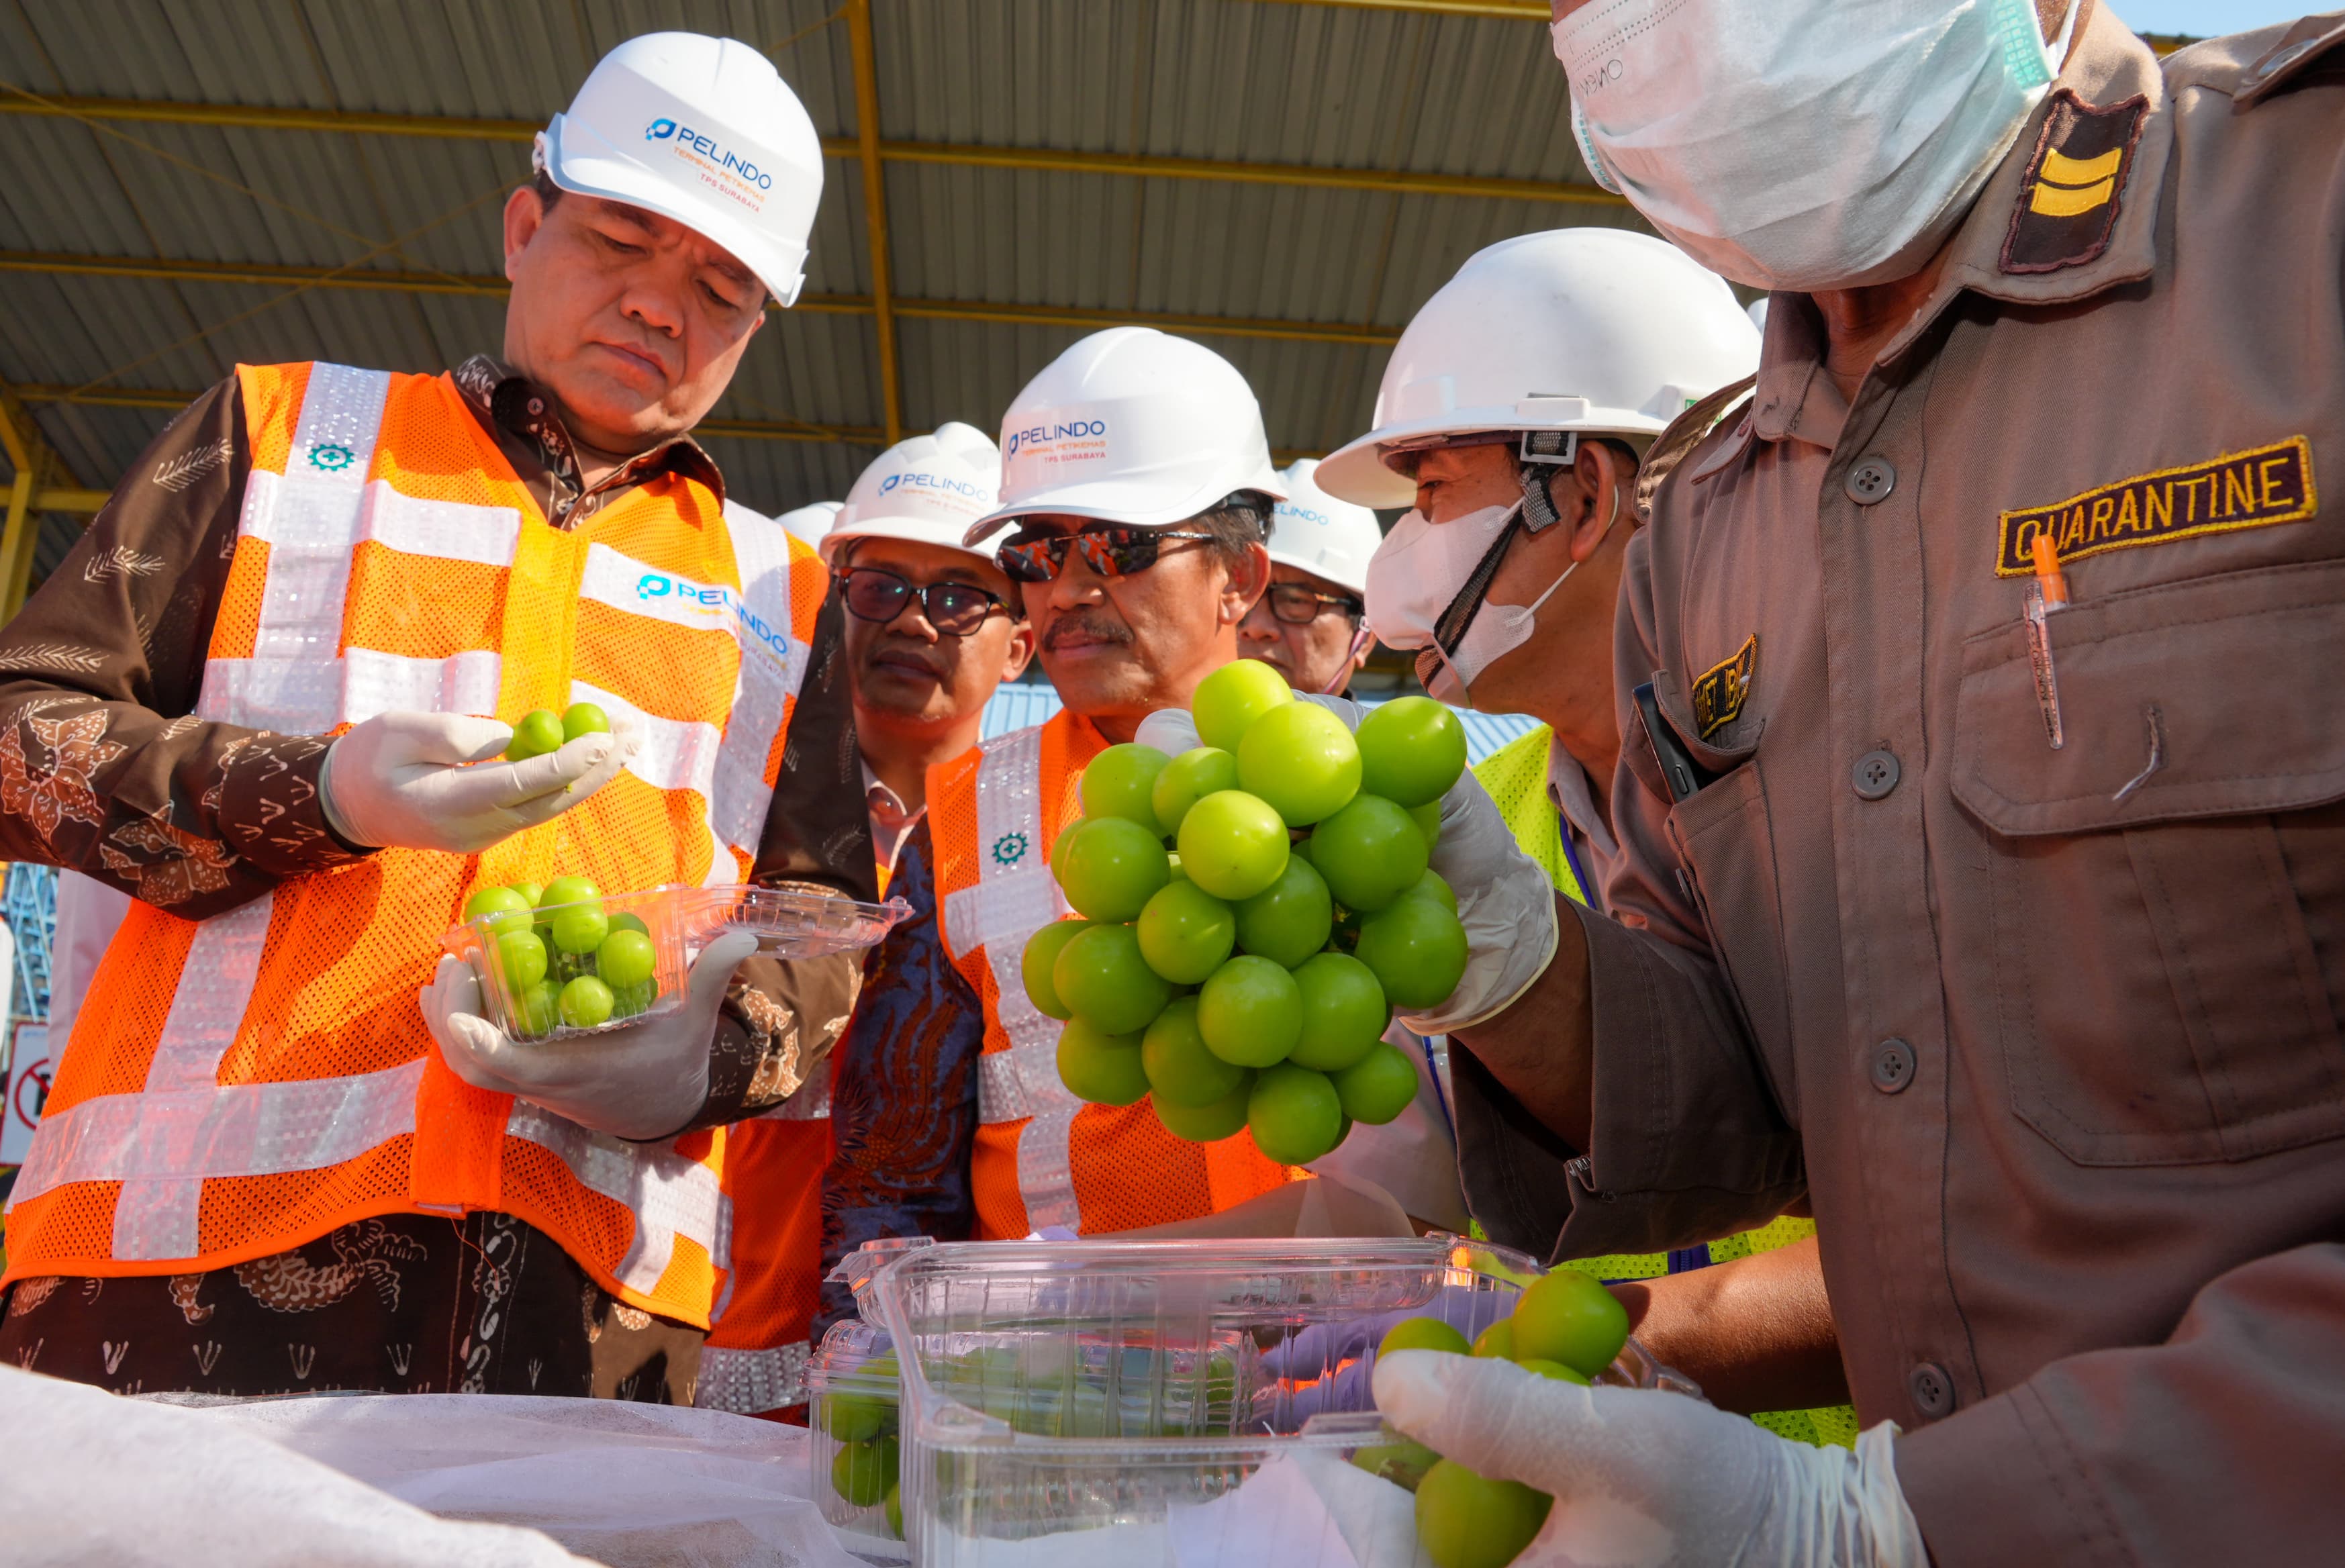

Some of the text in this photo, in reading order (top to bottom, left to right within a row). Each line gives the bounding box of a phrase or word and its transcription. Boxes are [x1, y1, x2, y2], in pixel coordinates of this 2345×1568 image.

[677, 127, 772, 189] PELINDO
[700, 173, 761, 213] TPS SURABAYA
[1021, 420, 1106, 446] PELINDO
[1044, 452, 1106, 464] TPS SURABAYA
[902, 473, 990, 502] PELINDO
[2015, 458, 2295, 562] QUARANTINE
[677, 583, 788, 654] PELINDO
